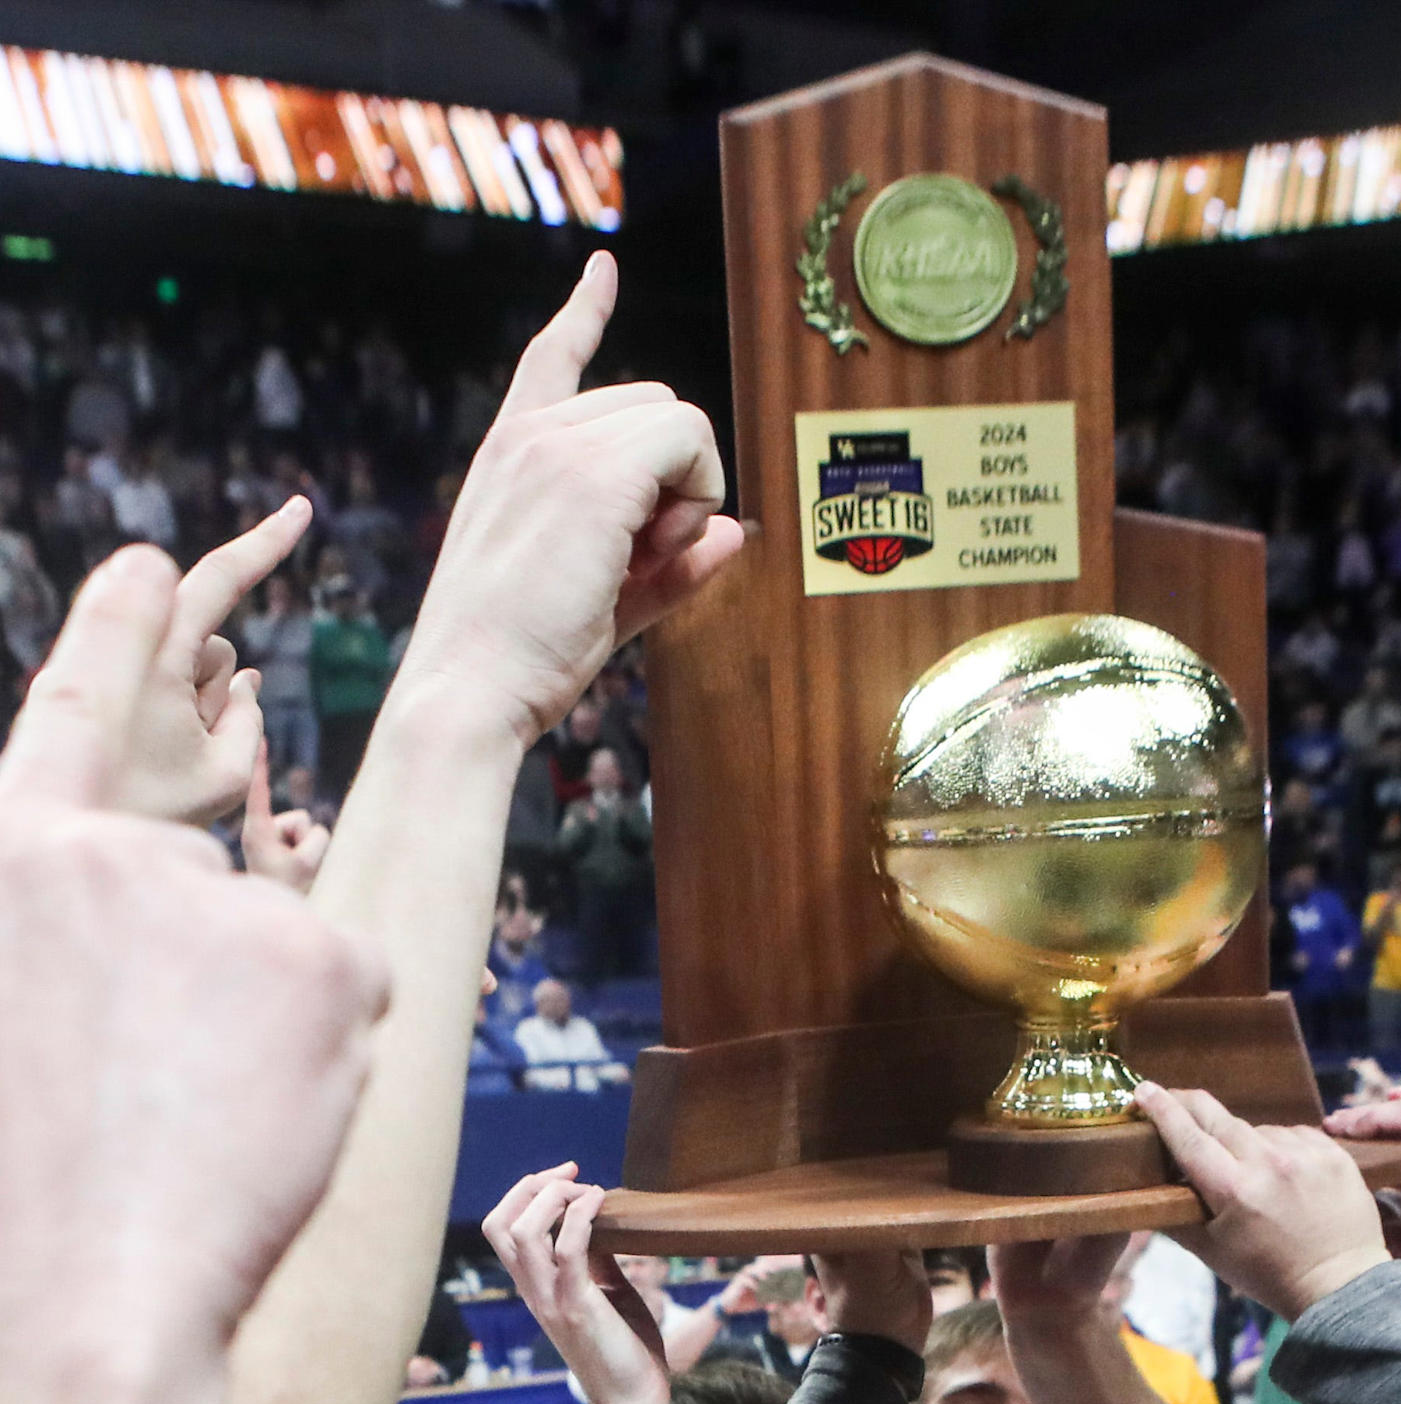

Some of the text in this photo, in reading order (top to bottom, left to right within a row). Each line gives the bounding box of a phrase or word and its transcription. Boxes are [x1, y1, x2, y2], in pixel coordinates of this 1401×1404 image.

[980, 422, 1027, 446] 2024
[980, 453, 1028, 477] BOYS
[946, 483, 1063, 510] BASKETBALL
[818, 497, 928, 538] SWEET 16
[980, 514, 1033, 538] STATE
[958, 544, 1058, 571] CHAMPION
